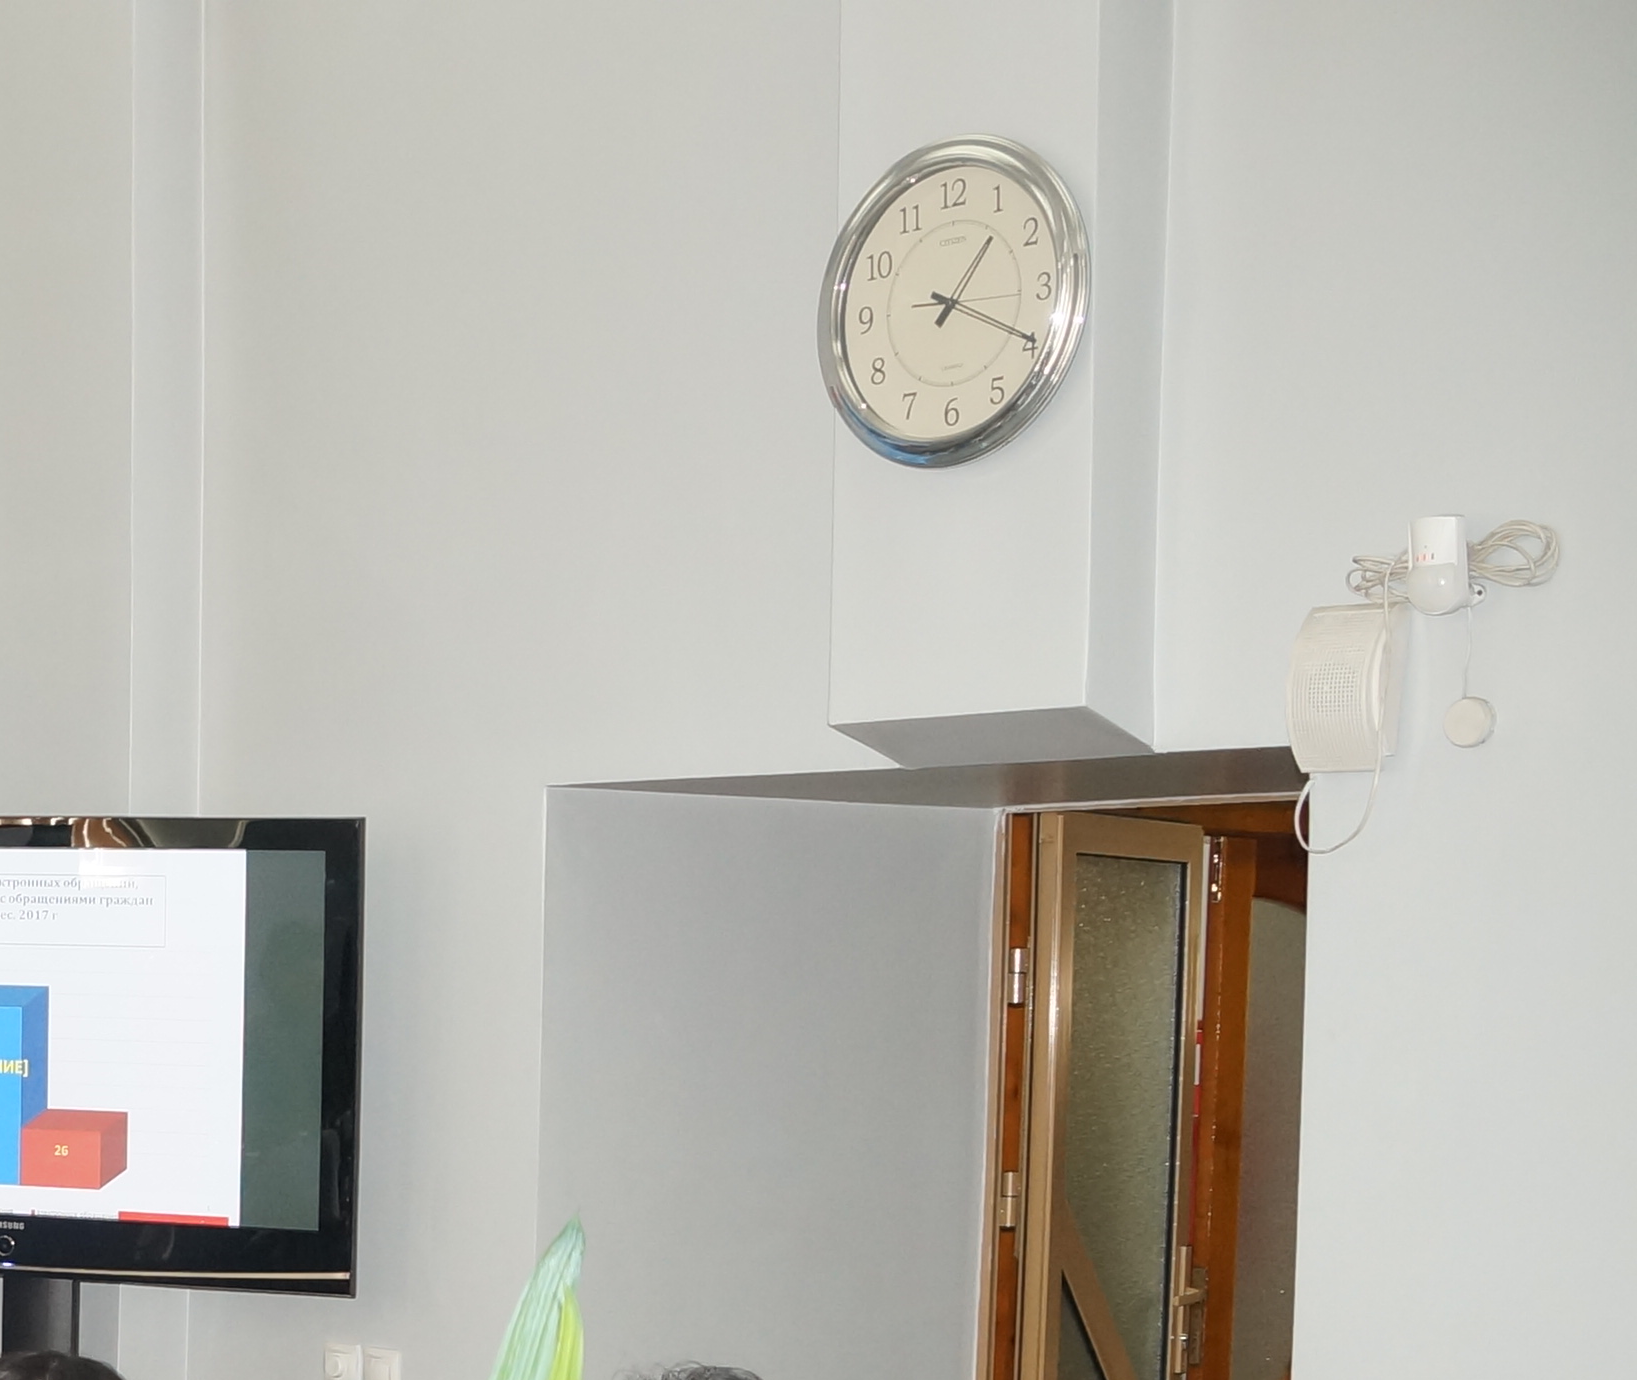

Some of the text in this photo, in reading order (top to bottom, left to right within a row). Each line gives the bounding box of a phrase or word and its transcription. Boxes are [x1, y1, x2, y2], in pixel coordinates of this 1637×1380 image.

[940, 178, 967, 211] 12
[993, 184, 1004, 213] 1
[899, 204, 923, 234] 11
[1023, 217, 1039, 247] 2
[866, 251, 893, 282] 10
[1036, 272, 1051, 300] 3
[859, 306, 874, 335] 9
[1022, 331, 1038, 359] 4
[871, 358, 886, 385] 8
[990, 376, 1004, 405] 5
[902, 392, 917, 420] 7
[944, 398, 959, 426] 6
[18, 909, 49, 920] 2017
[54, 1145, 69, 1156] 26
